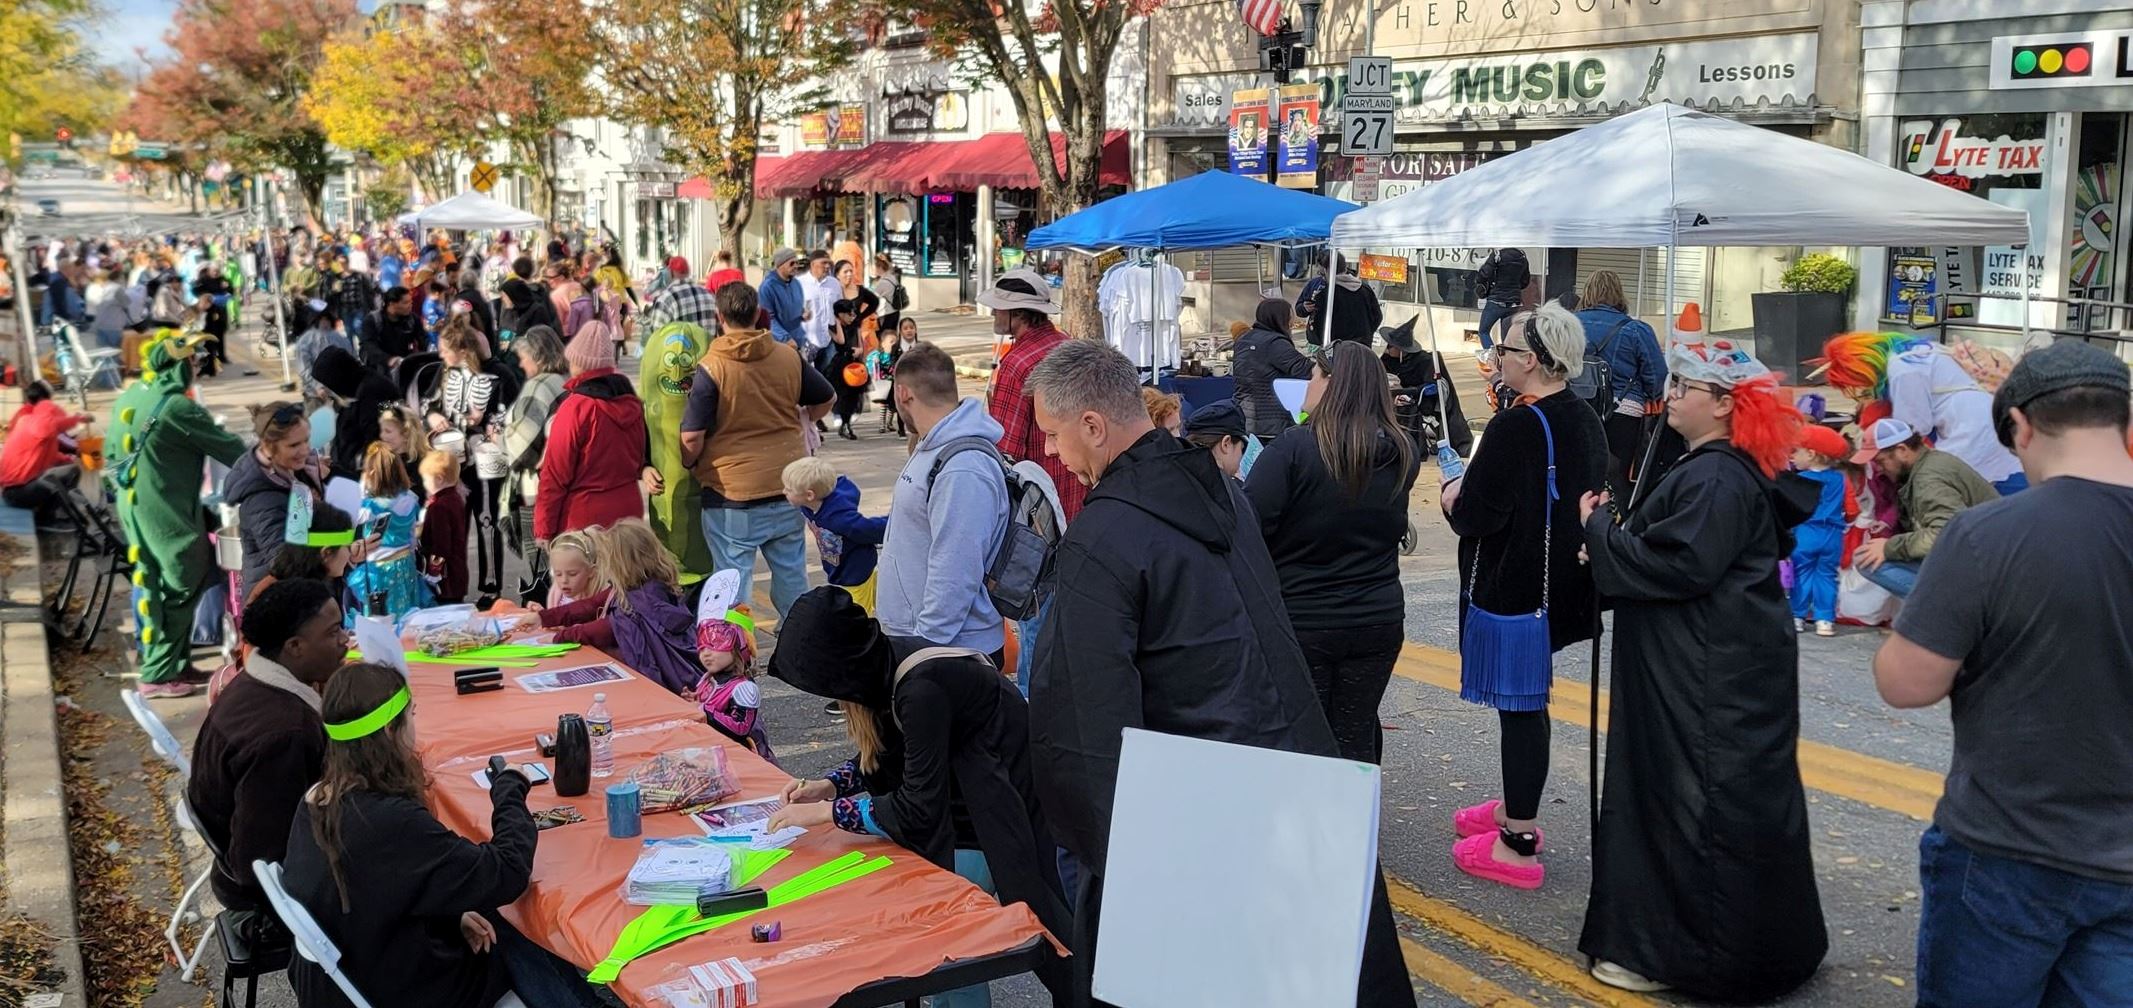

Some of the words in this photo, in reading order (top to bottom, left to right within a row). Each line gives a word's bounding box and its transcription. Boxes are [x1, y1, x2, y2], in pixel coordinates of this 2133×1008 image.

[1354, 62, 1387, 86] JCT
[1453, 57, 1606, 104] MUSIC
[1699, 63, 1795, 83] Lessons
[1185, 93, 1223, 107] Sales
[1347, 99, 1392, 108] MARYLAND
[1350, 117, 1387, 149] 27
[1934, 129, 1990, 167] LYTE
[1998, 146, 2044, 169] TAX
[1989, 252, 2017, 268] LYTE
[1946, 263, 1963, 292] YTE
[1989, 271, 2042, 289] SERVCE
